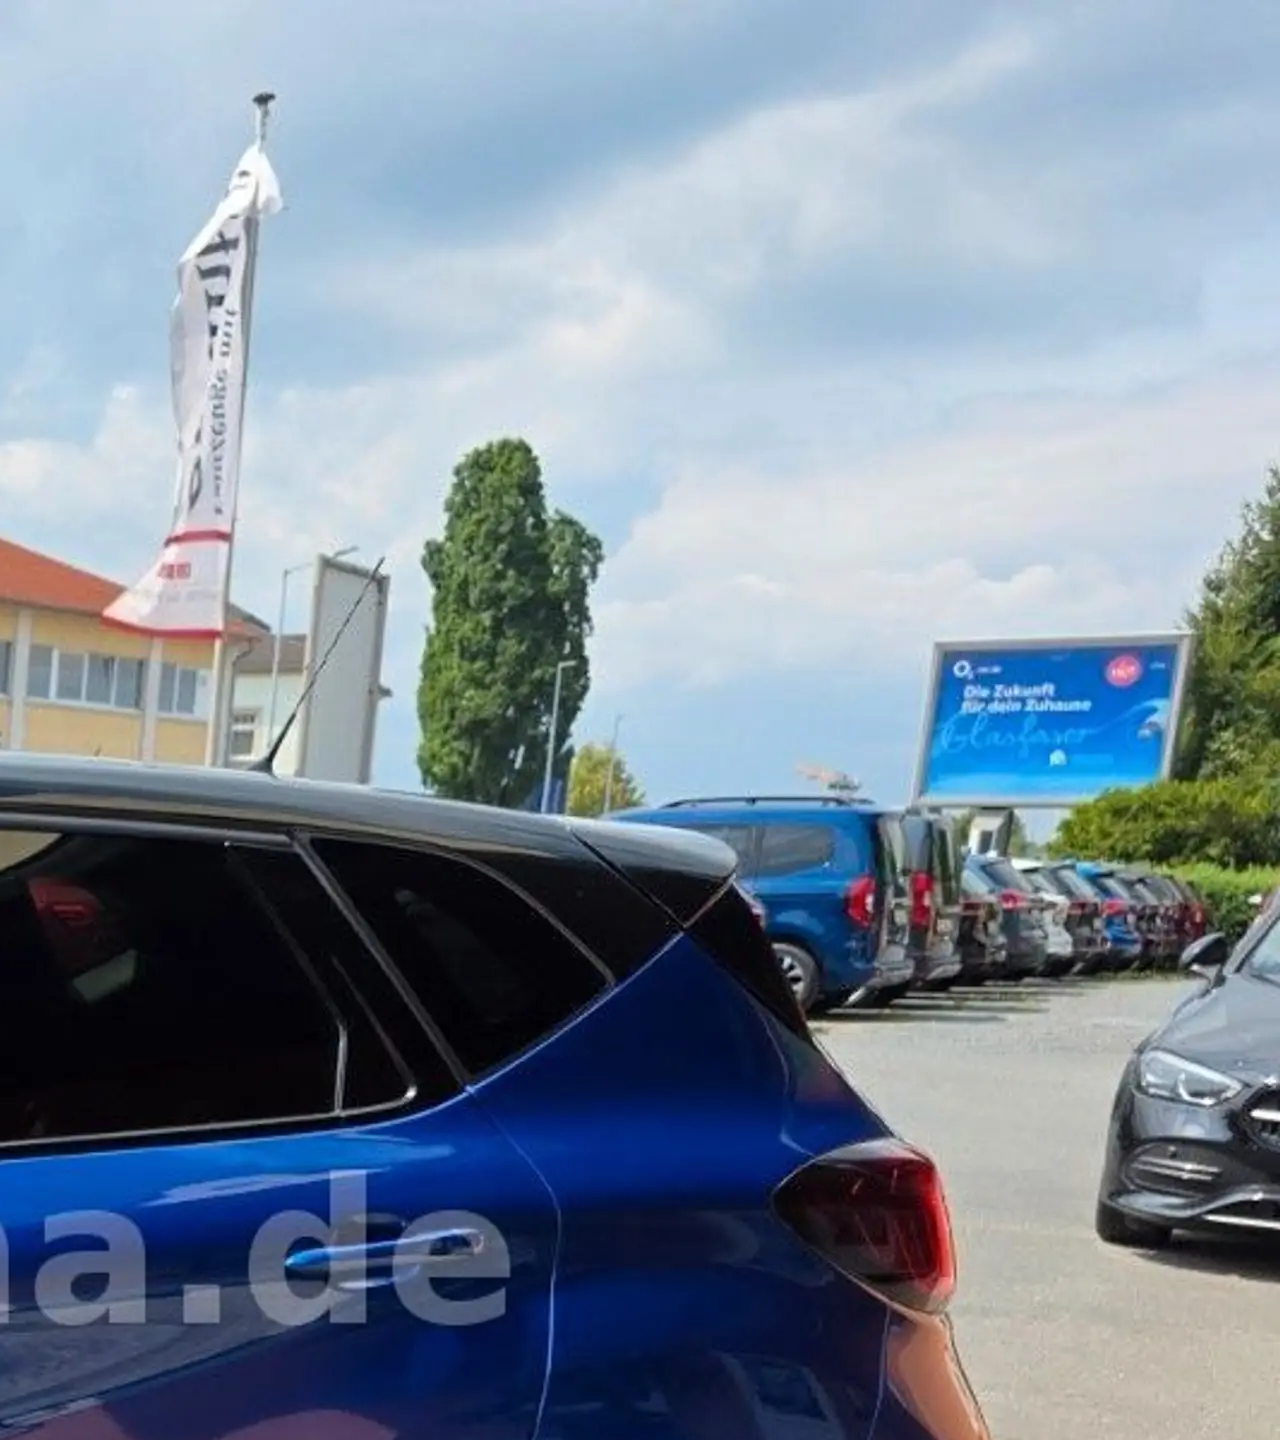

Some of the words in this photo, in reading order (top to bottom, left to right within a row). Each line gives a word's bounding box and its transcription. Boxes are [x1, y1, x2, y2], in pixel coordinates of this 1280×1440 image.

[963, 684, 990, 698] Die
[993, 682, 1056, 697] Zukunft
[1024, 699, 1093, 712] Zuhause
